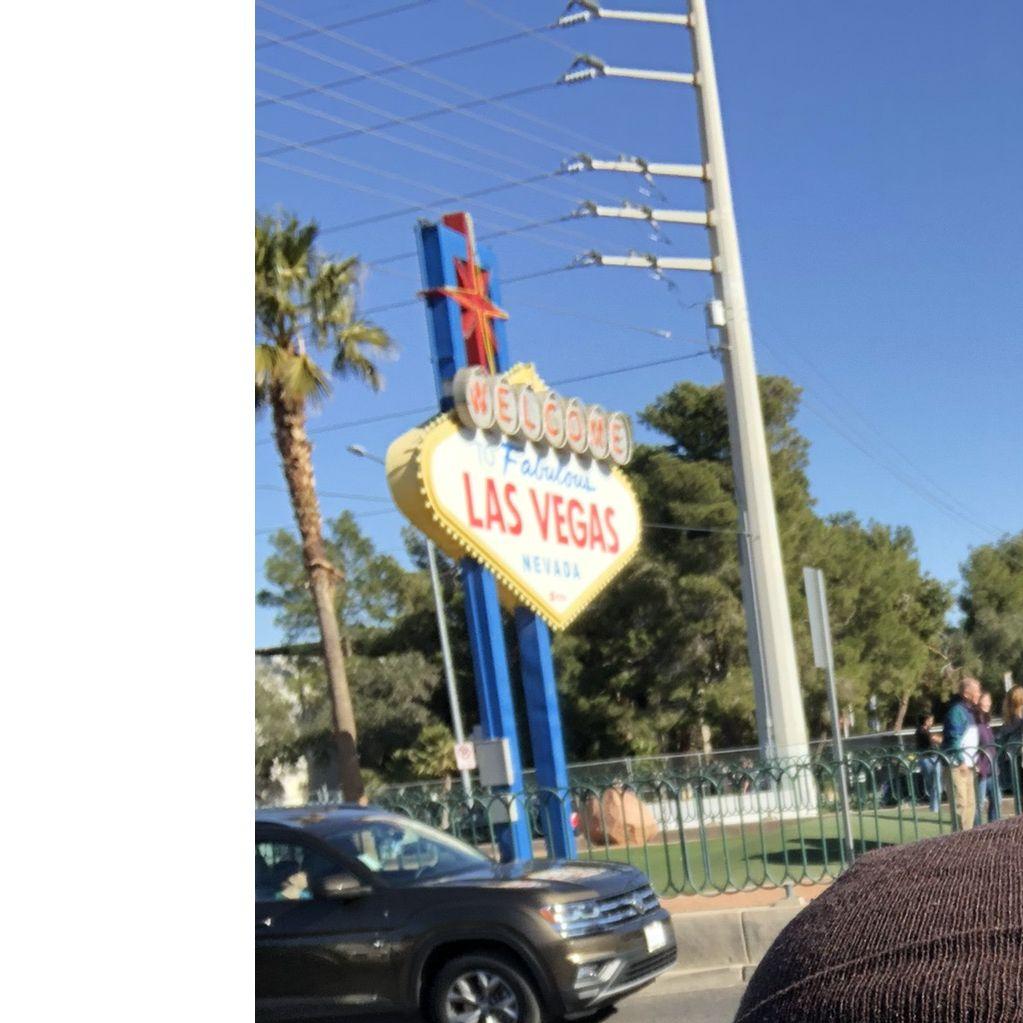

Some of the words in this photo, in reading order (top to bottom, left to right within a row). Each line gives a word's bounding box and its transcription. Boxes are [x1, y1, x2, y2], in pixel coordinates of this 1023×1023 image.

[470, 381, 623, 454] WELCOME
[501, 441, 596, 492] Fabulous
[462, 471, 522, 536] LAS
[529, 487, 619, 554] VEGAS
[522, 554, 581, 579] NEVADA
